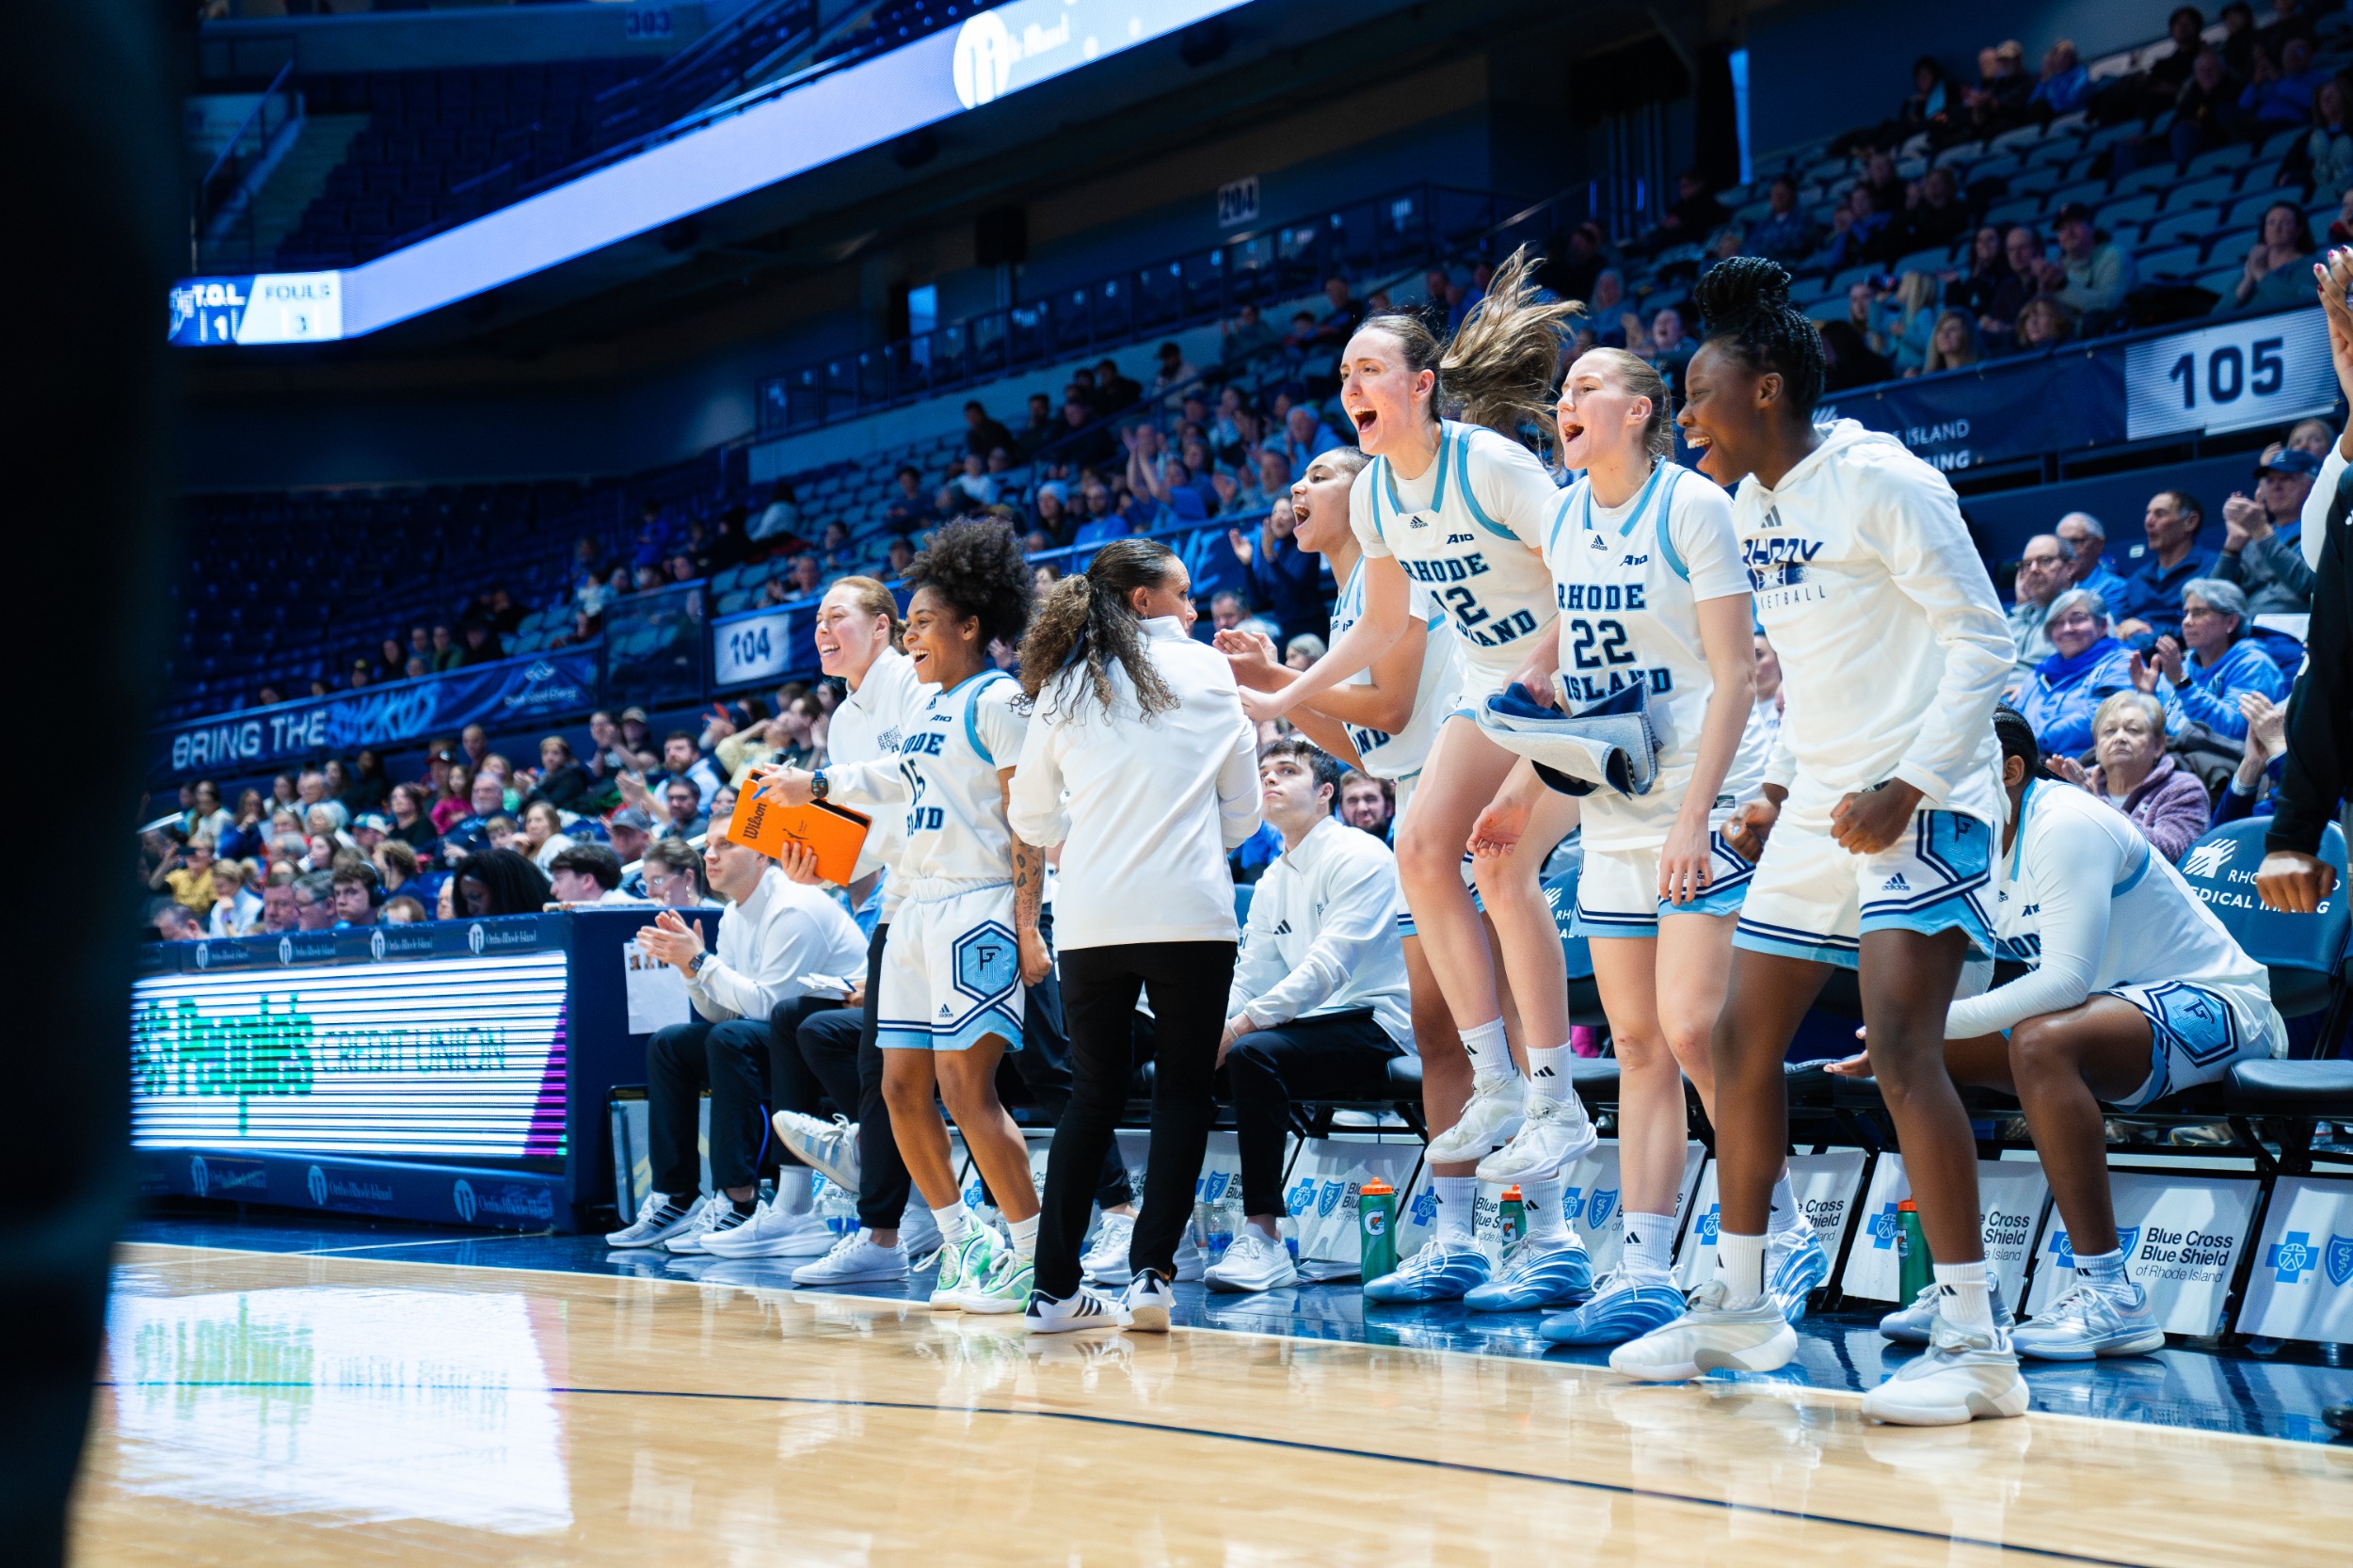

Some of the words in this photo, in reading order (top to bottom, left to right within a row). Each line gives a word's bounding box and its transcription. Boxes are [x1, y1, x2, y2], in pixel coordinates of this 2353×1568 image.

[264, 284, 330, 300] FOULS
[214, 316, 228, 341] 1
[2169, 336, 2284, 409] 105
[1905, 418, 1970, 446] ISLAND
[1446, 533, 1475, 544] A10
[1591, 543, 1609, 552] adidas
[1399, 551, 1491, 584] RHODE
[1619, 554, 1648, 567] A10
[1431, 584, 1491, 628] 12
[1558, 582, 1647, 612] RHODE
[730, 626, 771, 665] 104
[1570, 617, 1638, 670] 22
[930, 714, 952, 723] A10
[172, 722, 263, 771] BRING
[270, 711, 328, 750] THE
[899, 732, 947, 759] ODE
[900, 758, 926, 808] 15
[743, 803, 767, 840] Wilson
[2227, 869, 2258, 886] RHO
[1347, 1182, 1361, 1195] Blu
[1342, 1196, 1360, 1208] Blu
[1476, 1196, 1498, 1213] Blue
[1806, 1199, 1845, 1213] Cross
[1476, 1212, 1492, 1227] lue
[1989, 1211, 2030, 1228] Cross
[1983, 1228, 2027, 1245] Shield
[2146, 1226, 2182, 1244] Blue
[2185, 1229, 2233, 1249] Cross
[1993, 1249, 2023, 1261] Island
[2139, 1245, 2177, 1263] Blue
[2179, 1247, 2230, 1266] Shield
[2136, 1265, 2150, 1277] of
[2149, 1266, 2187, 1280] Rhode
[2188, 1268, 2224, 1283] Island
